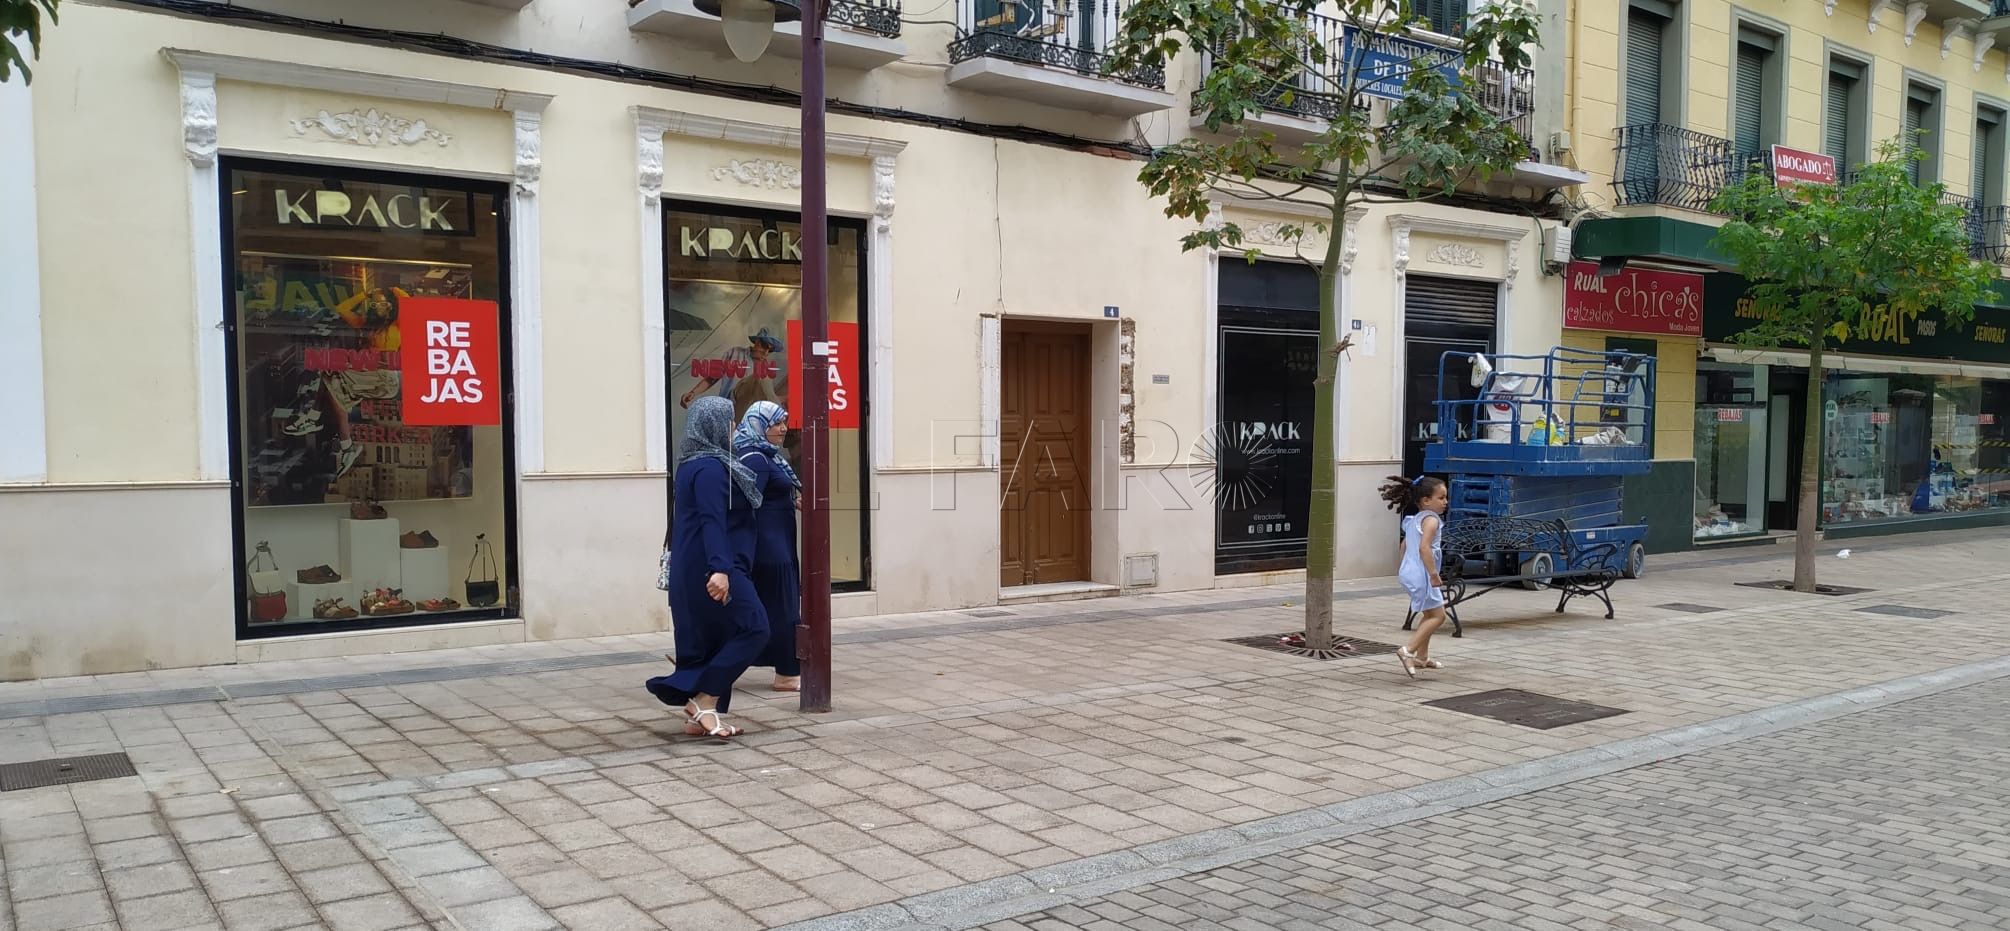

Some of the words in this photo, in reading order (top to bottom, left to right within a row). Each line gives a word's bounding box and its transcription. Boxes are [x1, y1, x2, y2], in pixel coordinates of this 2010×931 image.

[1777, 155, 1821, 174] ABOGADO
[275, 189, 453, 230] KRACK
[681, 226, 802, 260] KRACK
[1574, 272, 1607, 293] RUAL
[1109, 308, 1114, 316] 4
[1567, 301, 1614, 324] calzados
[426, 320, 470, 347] RE
[428, 350, 476, 375] BA
[420, 378, 482, 403] JAS
[1240, 421, 1301, 440] KRACK
